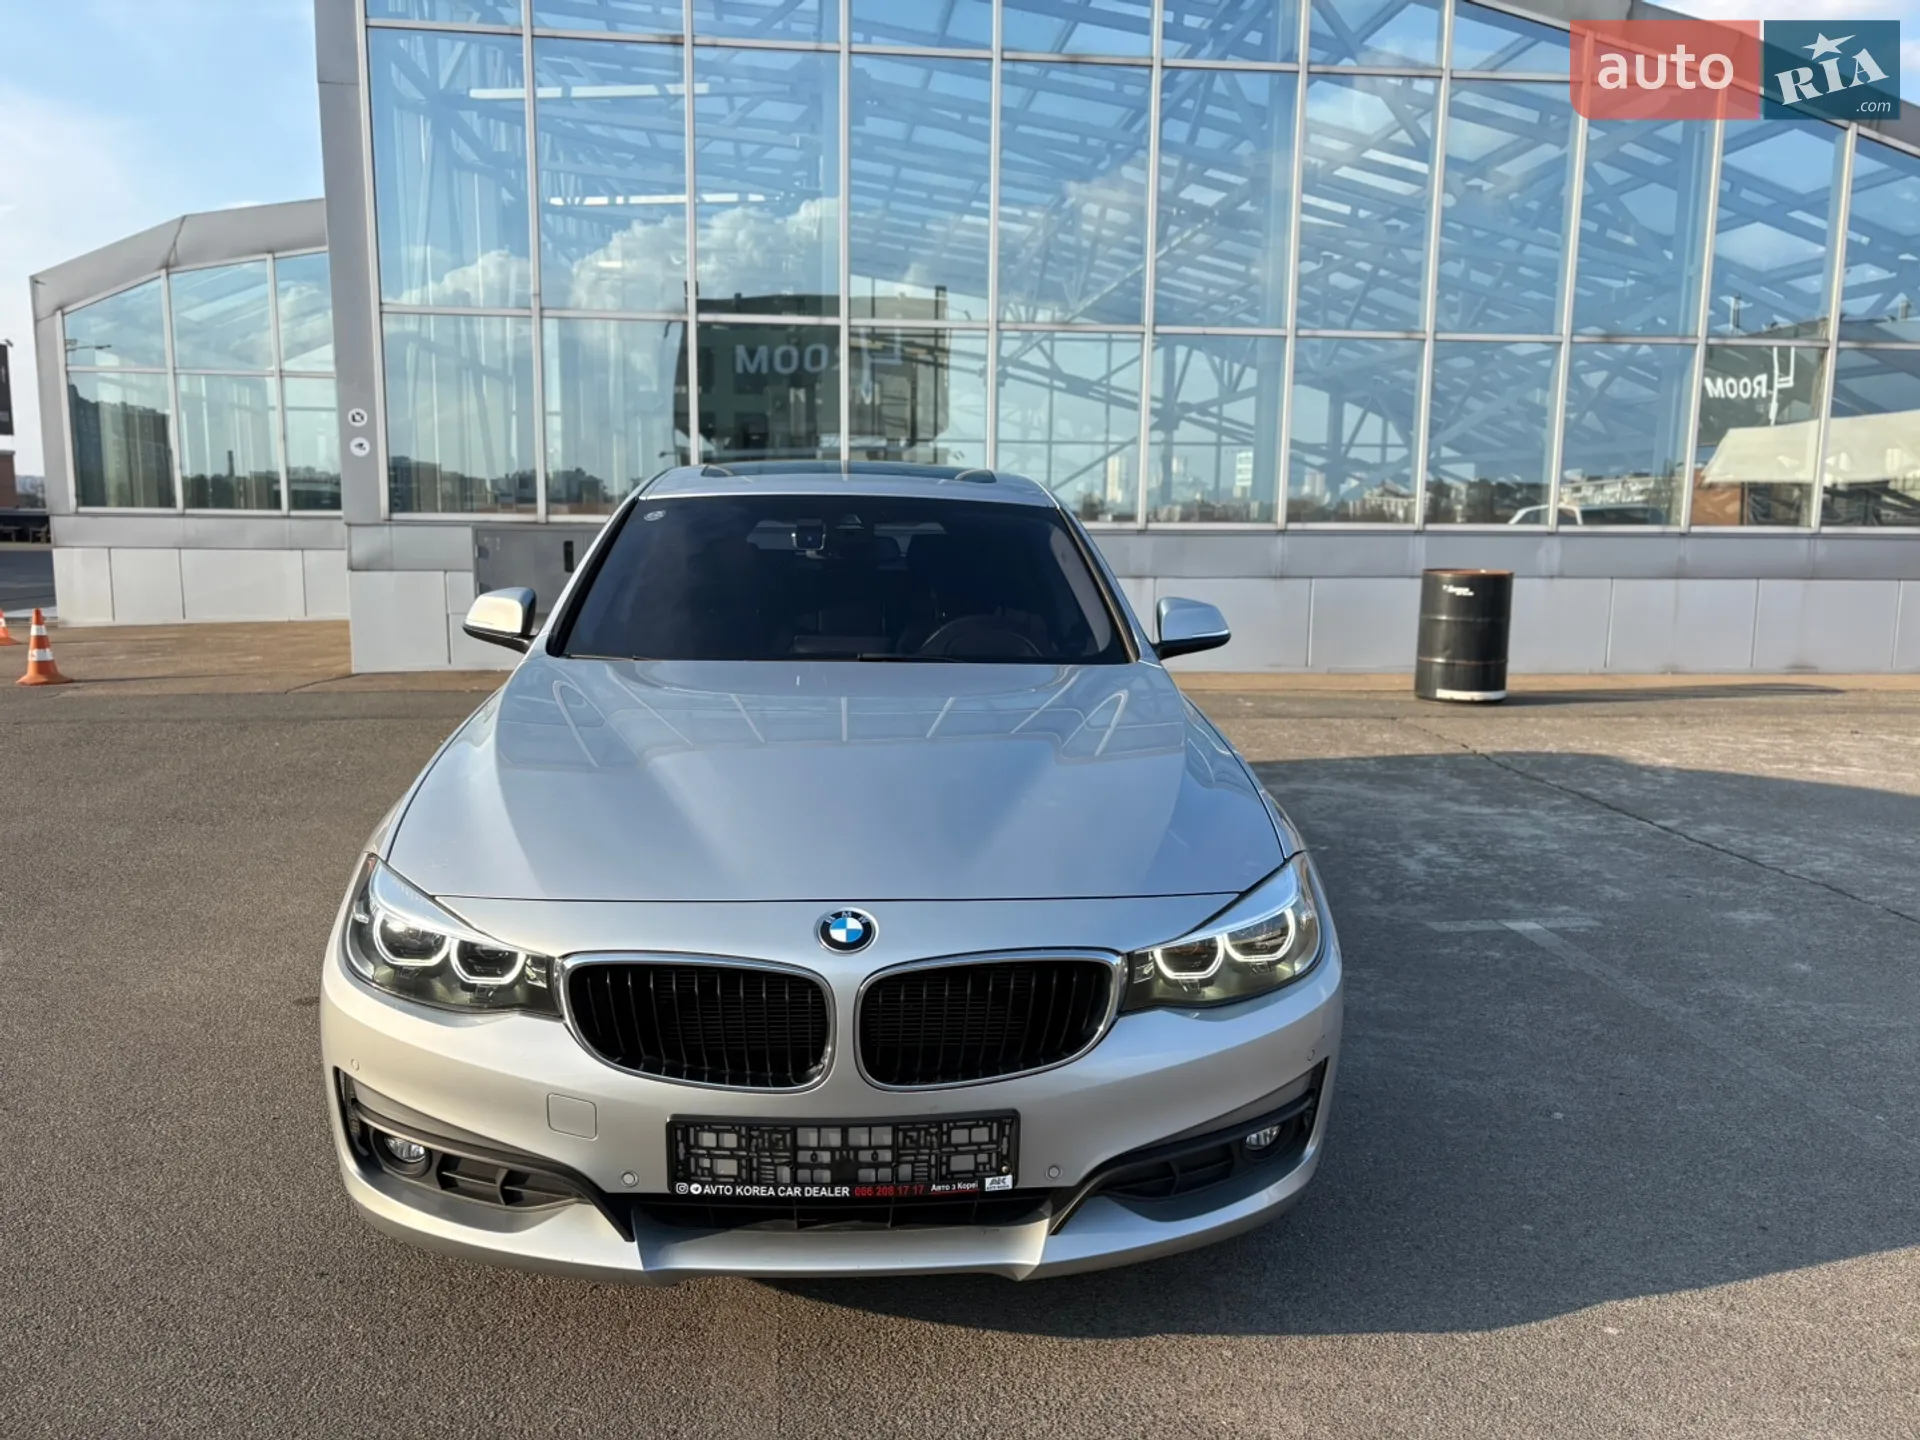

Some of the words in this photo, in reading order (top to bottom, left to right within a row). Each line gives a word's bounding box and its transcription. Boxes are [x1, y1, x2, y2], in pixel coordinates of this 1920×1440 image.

[703, 1184, 733, 1195] AVTO
[736, 1185, 775, 1196] KOREA
[777, 1186, 802, 1197] CAR
[804, 1186, 850, 1197] DEALER
